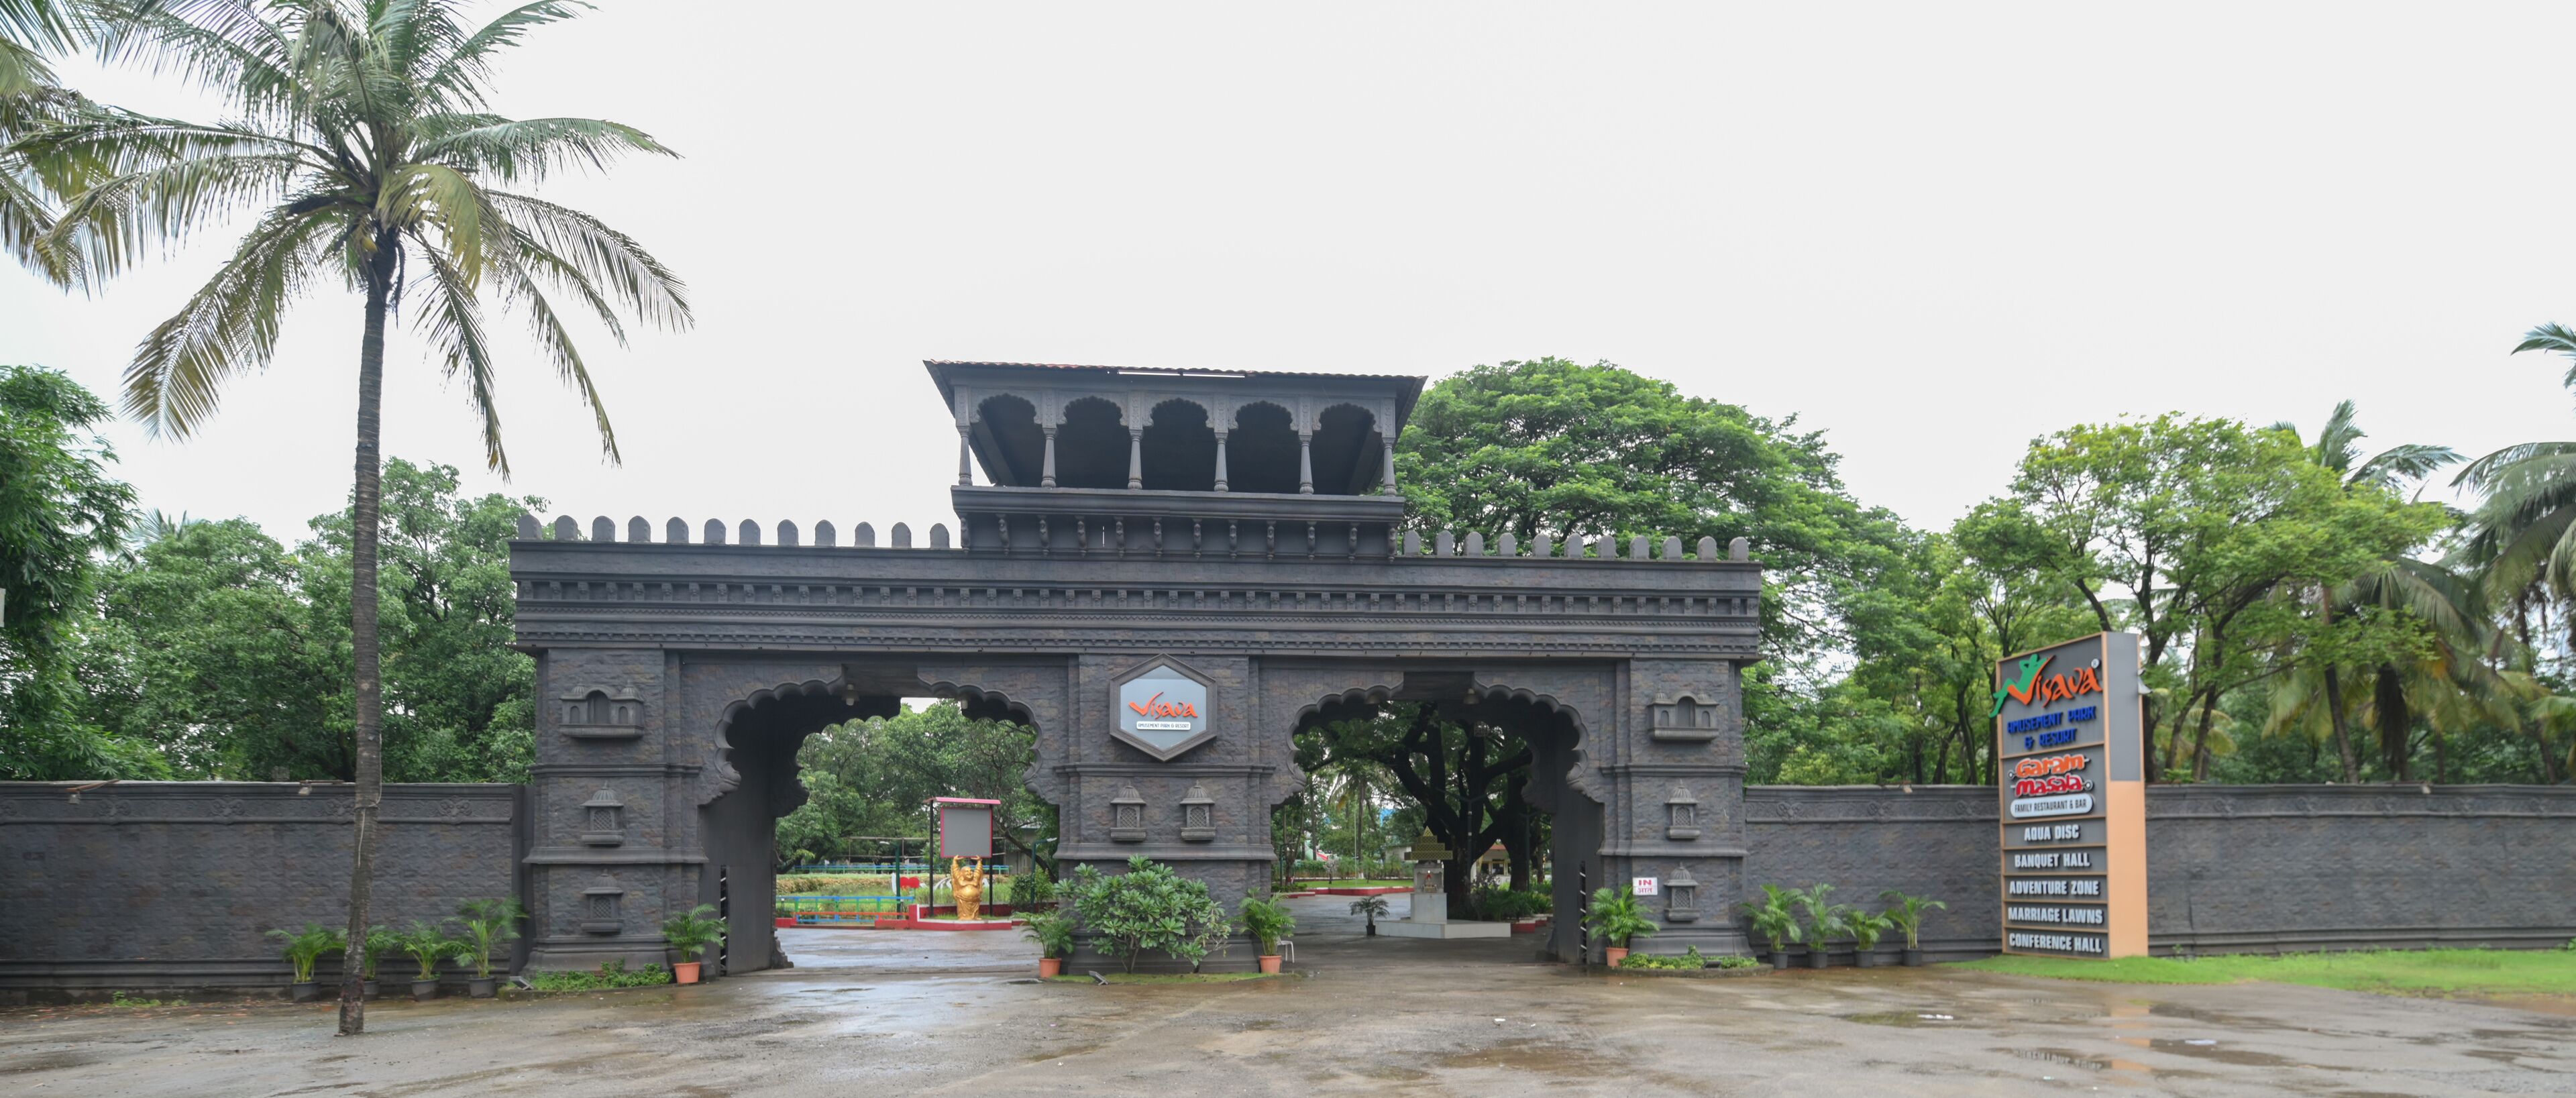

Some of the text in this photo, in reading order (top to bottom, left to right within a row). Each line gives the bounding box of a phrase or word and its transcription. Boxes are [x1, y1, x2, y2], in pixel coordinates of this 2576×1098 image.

[1128, 692, 1198, 720] Visava
[2007, 706, 2096, 733] AMUSEMENT PARK
[2025, 728, 2077, 749] & RESORT
[2015, 799, 2087, 813] FAMILY RESTAURANT & BAR
[2024, 824, 2079, 840] AQUA DISC
[2015, 853, 2090, 868] BANQUET HALL
[2009, 880, 2099, 895] ADVENTURE ZONE
[2008, 907, 2103, 924] MARRIAGE LAWNS
[2009, 932, 2102, 952] CONFERENCE HALL
